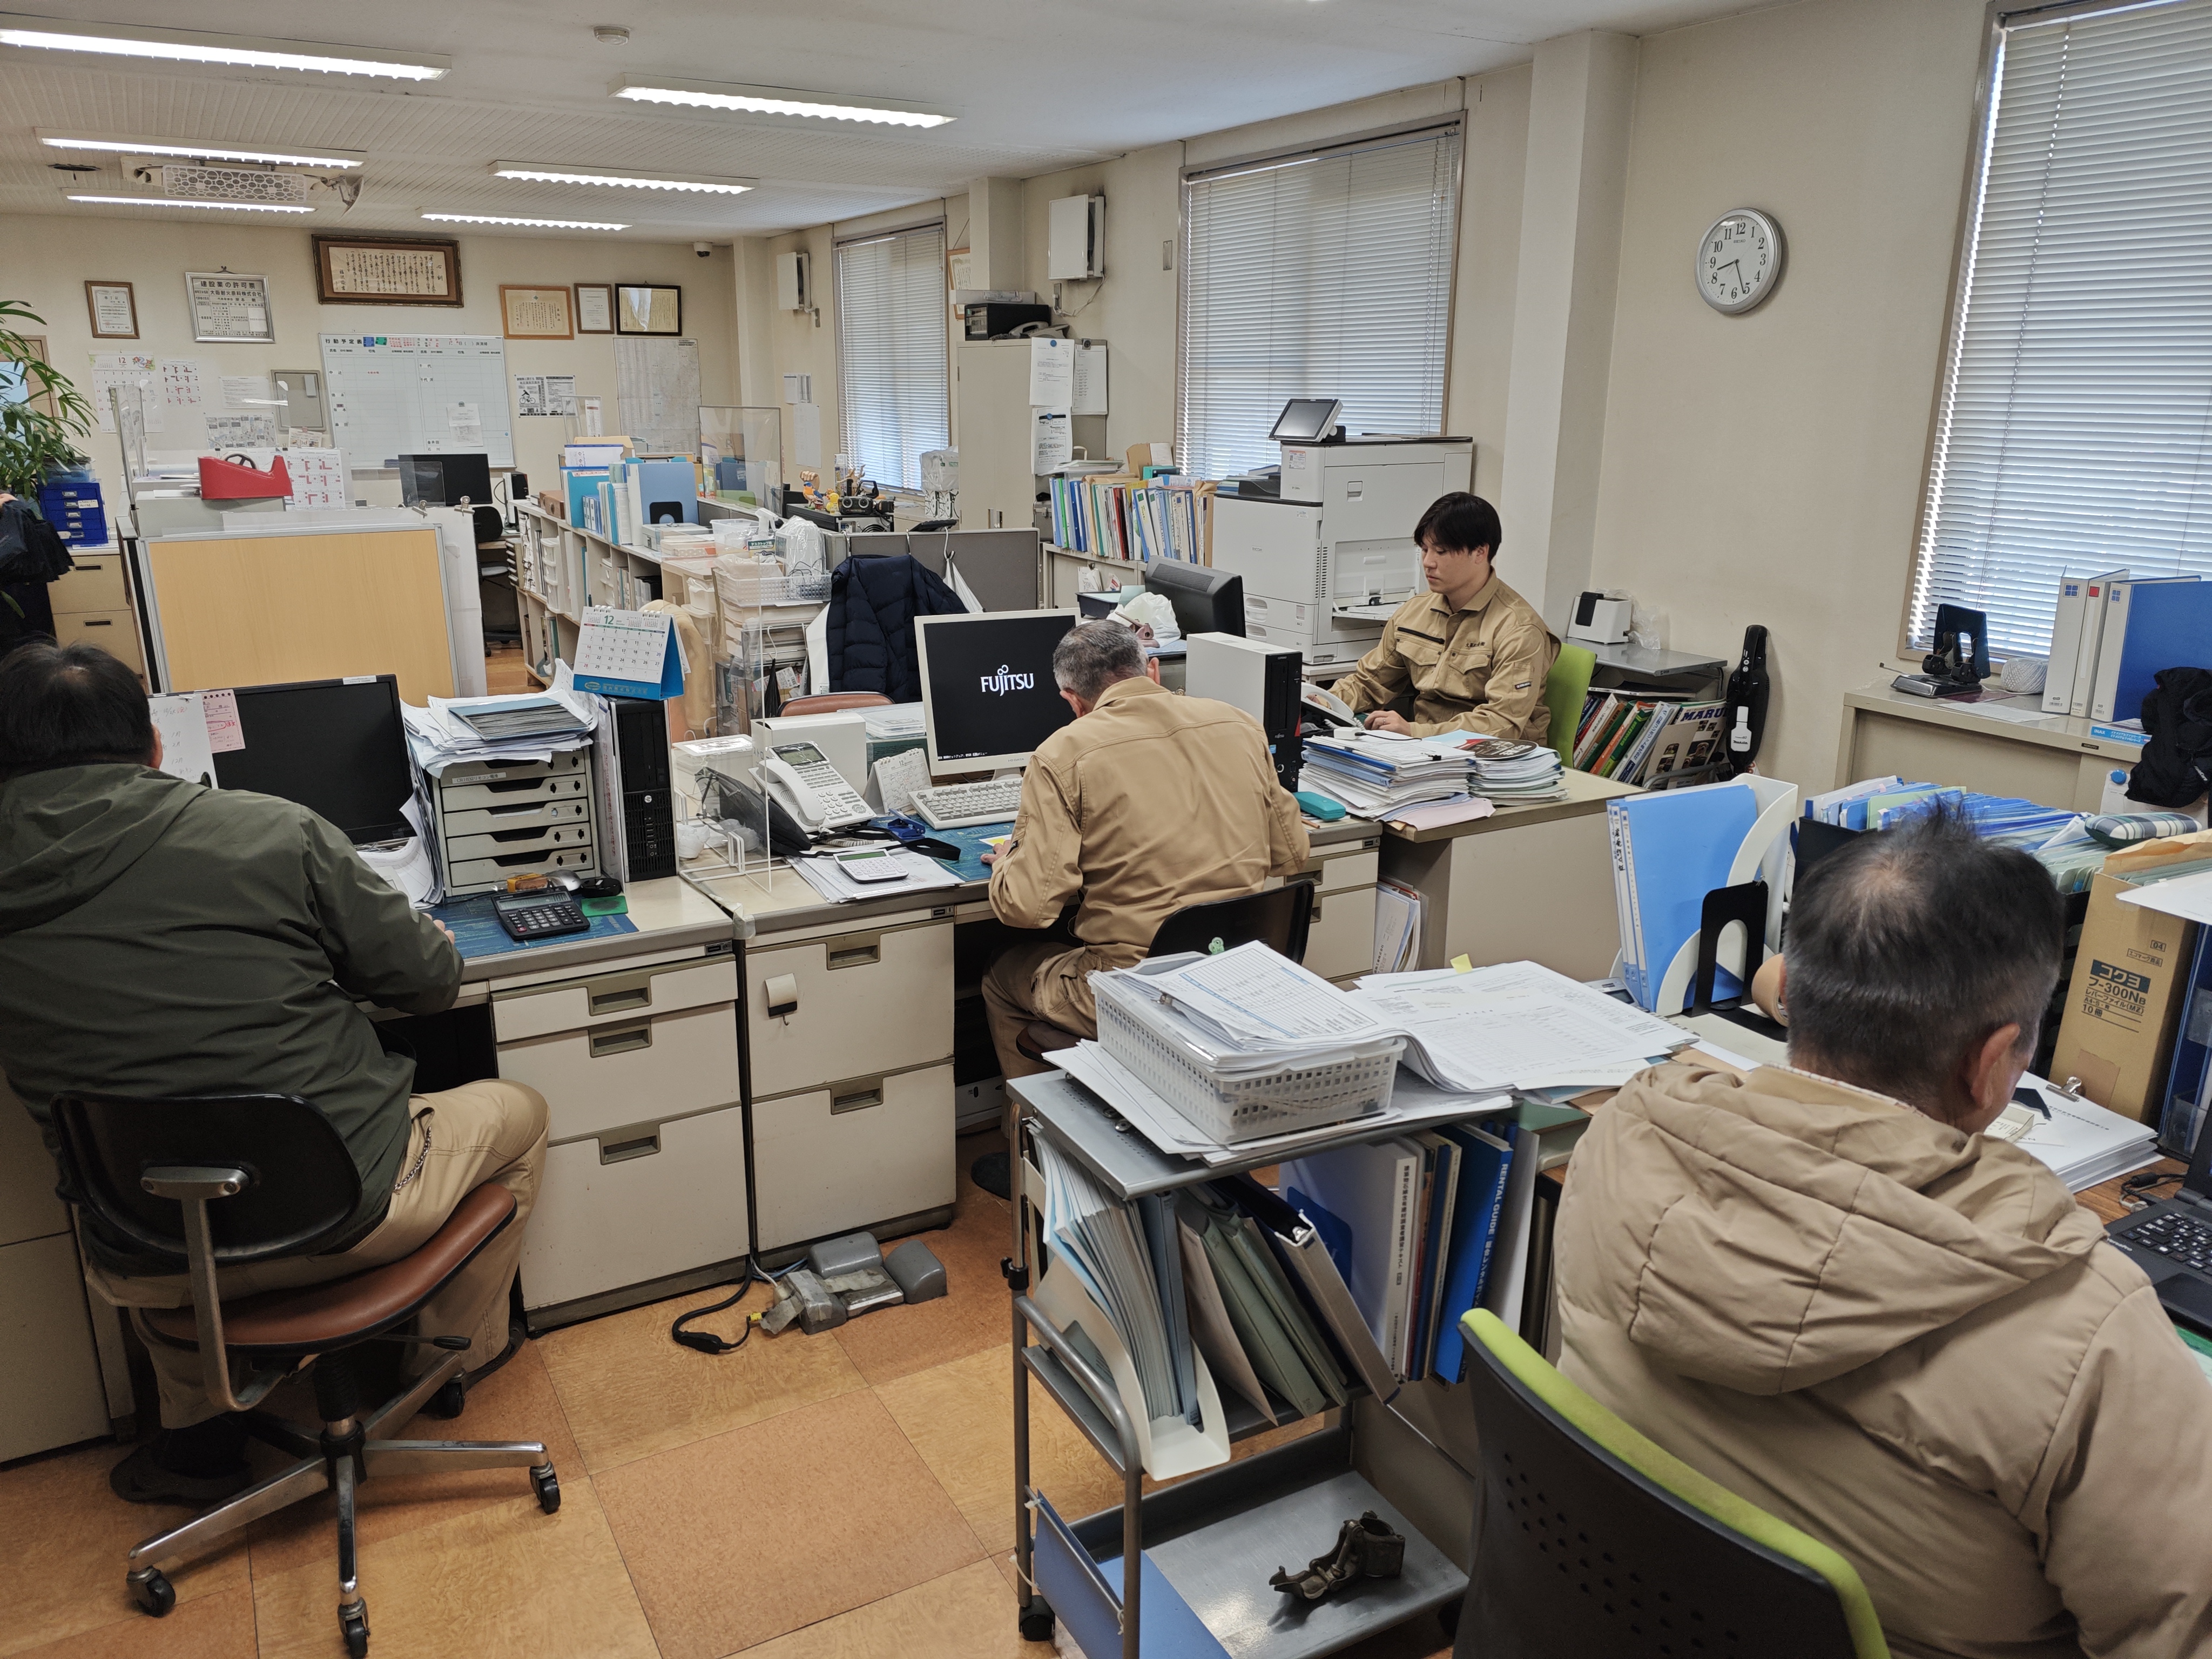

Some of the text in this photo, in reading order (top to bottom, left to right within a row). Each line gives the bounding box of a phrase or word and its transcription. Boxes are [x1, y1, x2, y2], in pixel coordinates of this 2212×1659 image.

[1724, 228, 1732, 240] 11
[1736, 222, 1746, 235] 12
[1750, 226, 1755, 238] 1
[1713, 240, 1723, 253] 10
[1757, 237, 1765, 249] 2
[1710, 257, 1716, 268] 9
[1759, 253, 1766, 266] 3
[1711, 272, 1718, 284] 8
[1754, 269, 1761, 282] 4
[201, 280, 255, 289] 建設業の許可票
[1719, 284, 1725, 295] 7
[1744, 282, 1750, 294] 5
[1731, 287, 1737, 299] 6
[604, 615, 614, 624] 12
[980, 665, 1034, 696] FUJITSU
[1680, 707, 1727, 721] MARU
[2153, 942, 2163, 950] 04
[2129, 950, 2160, 965] エコマーク商品
[2099, 965, 2141, 989] コクヨ
[2086, 988, 2144, 1015] レバーファイル(MZ)
[1495, 1163, 1508, 1203] RENTAL
[1488, 1204, 1500, 1235] GUIDE
